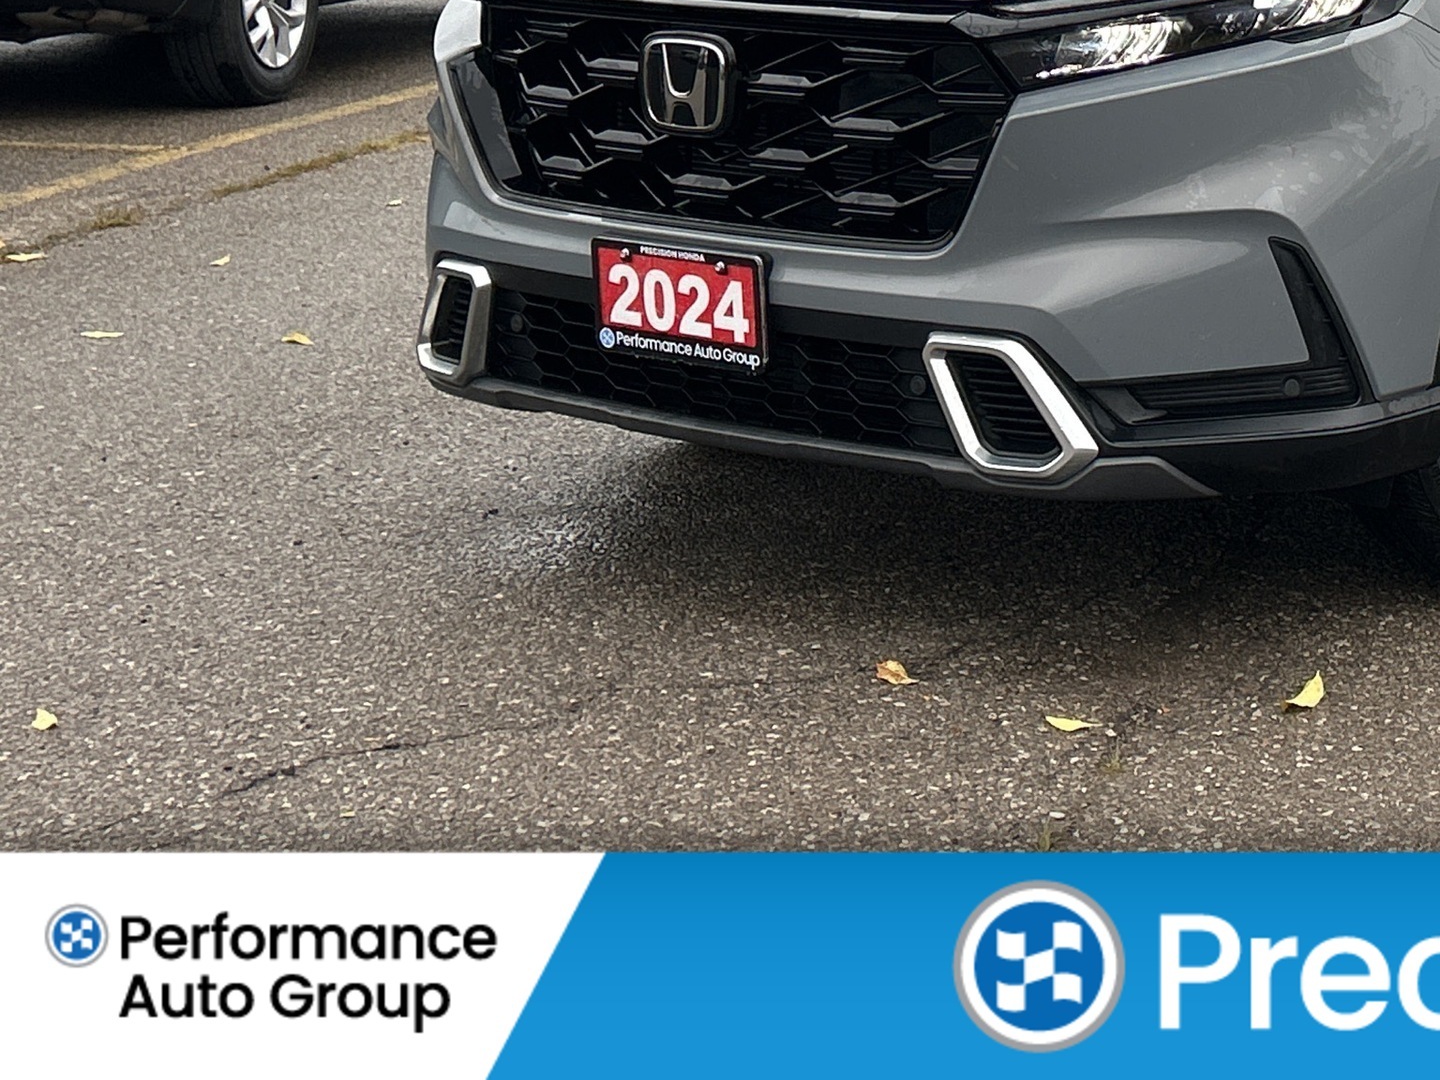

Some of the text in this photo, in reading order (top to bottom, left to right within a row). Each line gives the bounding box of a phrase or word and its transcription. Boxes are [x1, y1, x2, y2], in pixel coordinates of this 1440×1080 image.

[639, 245, 706, 263] PRECISION HONDA
[607, 263, 750, 344] 2024
[616, 331, 761, 371] Performance Auto Group
